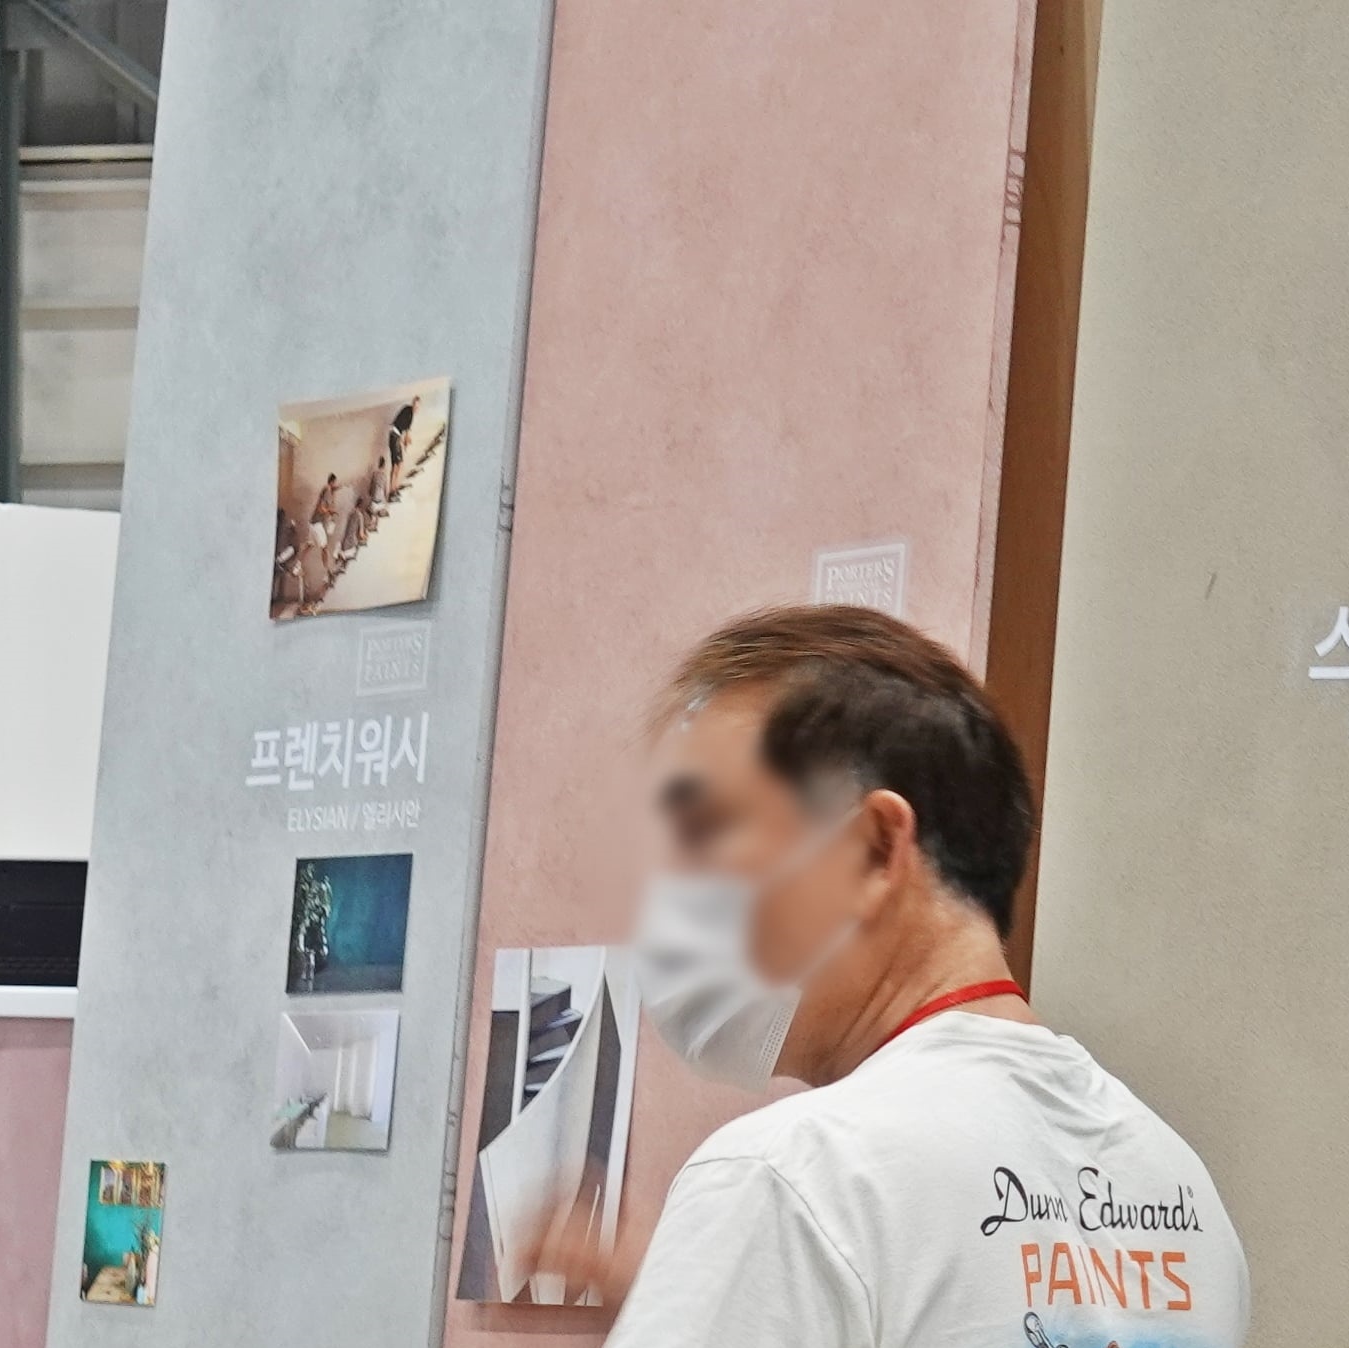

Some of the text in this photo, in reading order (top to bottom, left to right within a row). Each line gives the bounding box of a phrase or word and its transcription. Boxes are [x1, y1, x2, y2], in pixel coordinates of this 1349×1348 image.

[244, 711, 430, 791] 프렌치워시
[286, 804, 349, 833] ELYSIAN
[362, 797, 422, 831] 엘리시안
[980, 1166, 1068, 1237] Dunn
[1020, 1242, 1192, 1311] PAINTS
